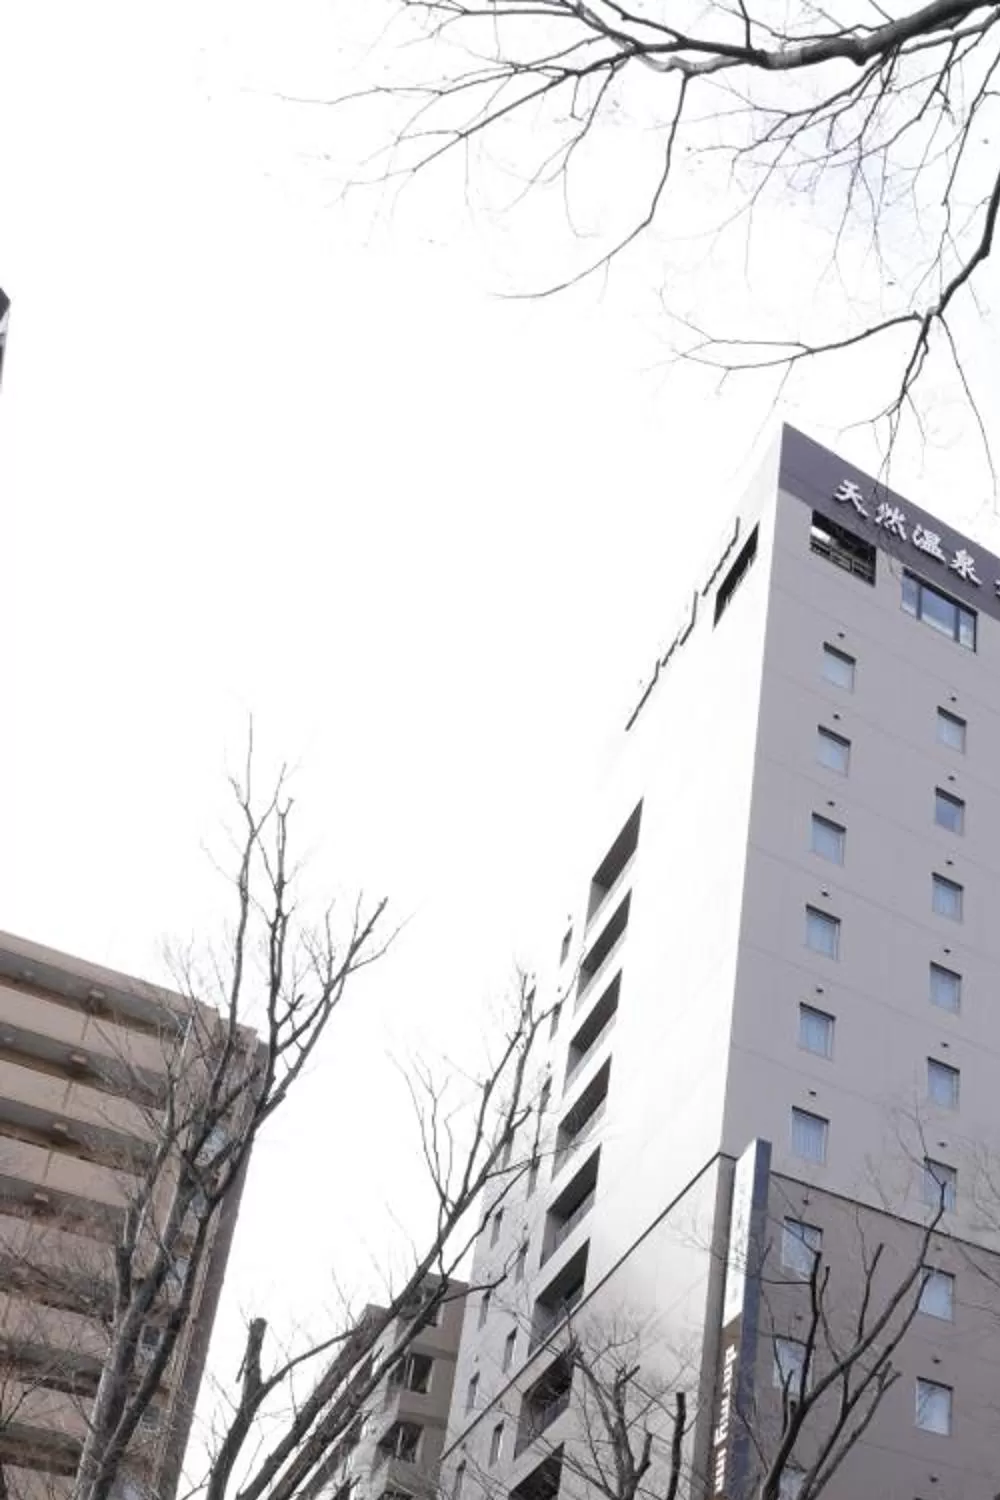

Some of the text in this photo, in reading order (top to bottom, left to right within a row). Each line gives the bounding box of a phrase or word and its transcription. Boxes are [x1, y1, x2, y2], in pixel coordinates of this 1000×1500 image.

[834, 479, 983, 586] 天然温泉
[714, 1344, 737, 1446] dormy
